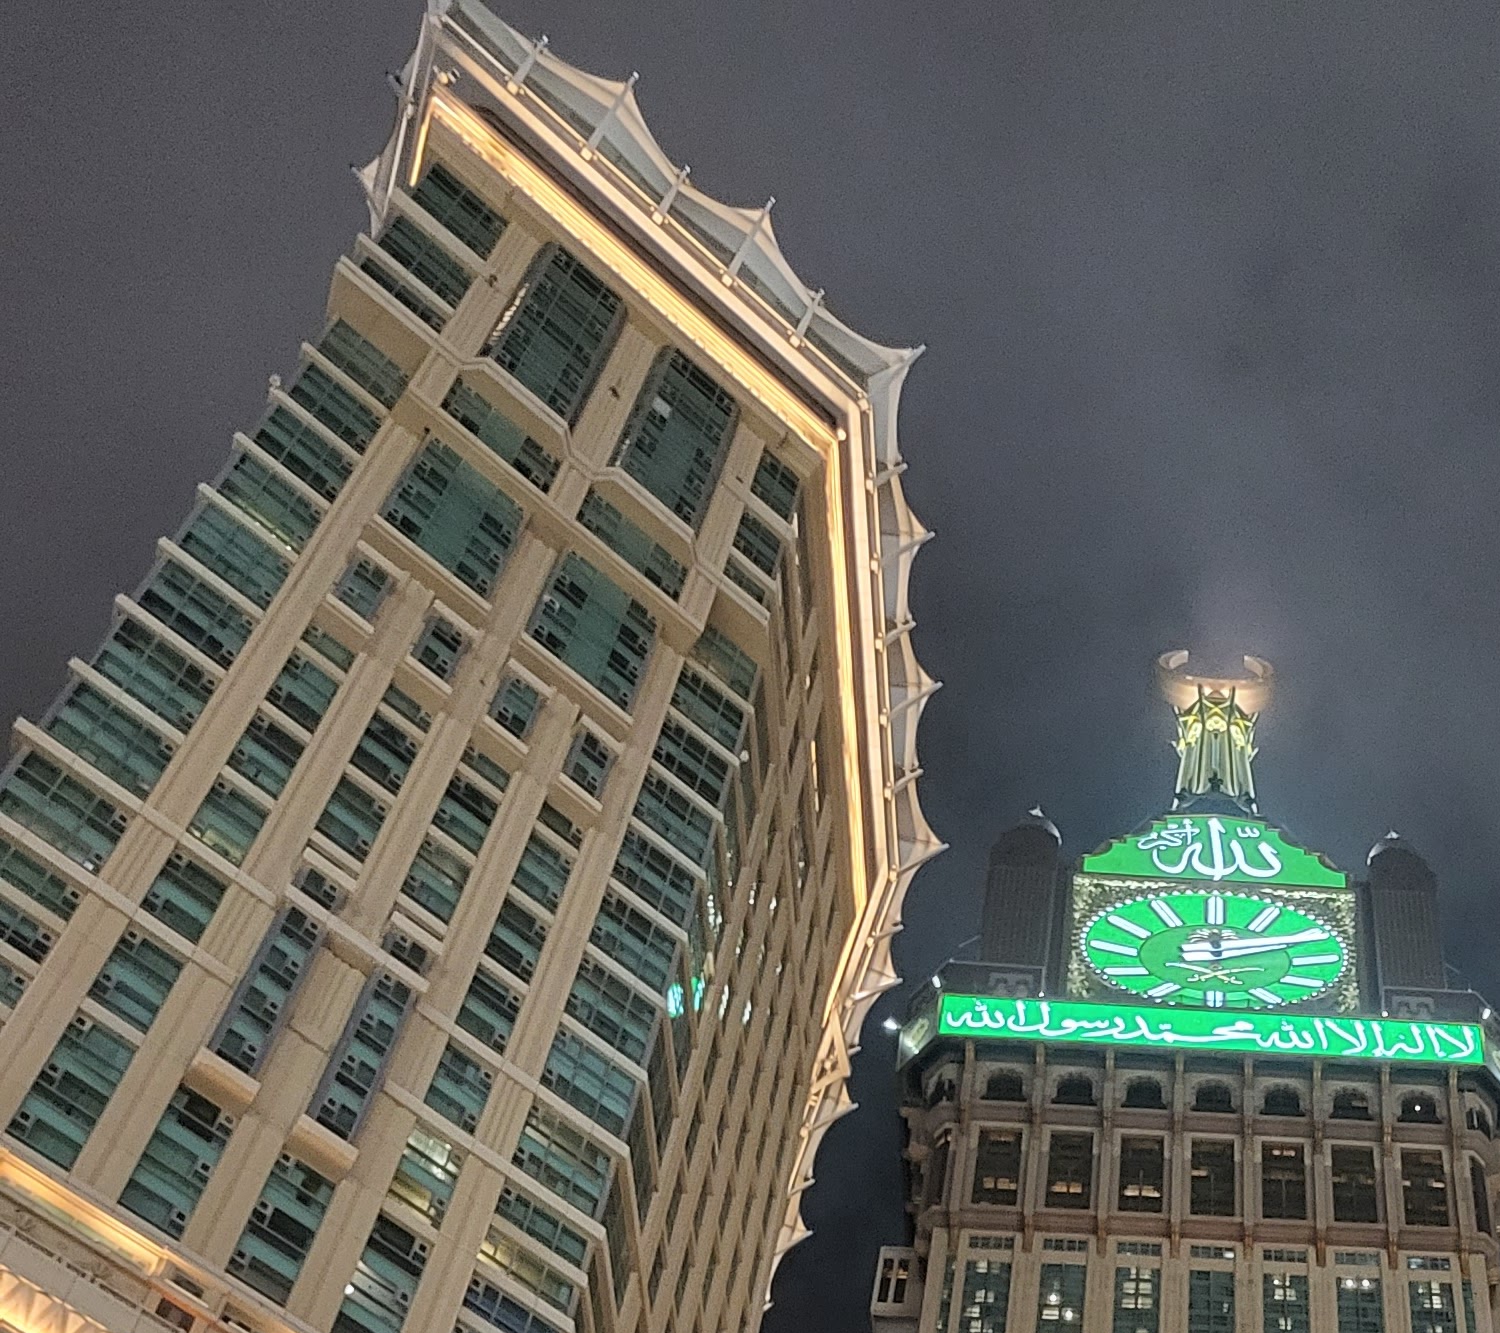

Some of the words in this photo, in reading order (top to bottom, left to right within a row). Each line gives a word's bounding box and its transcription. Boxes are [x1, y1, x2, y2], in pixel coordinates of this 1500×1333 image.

[946, 999, 1025, 1030] الله
[1256, 1018, 1328, 1051] الله
[1435, 1025, 1475, 1059] لا
